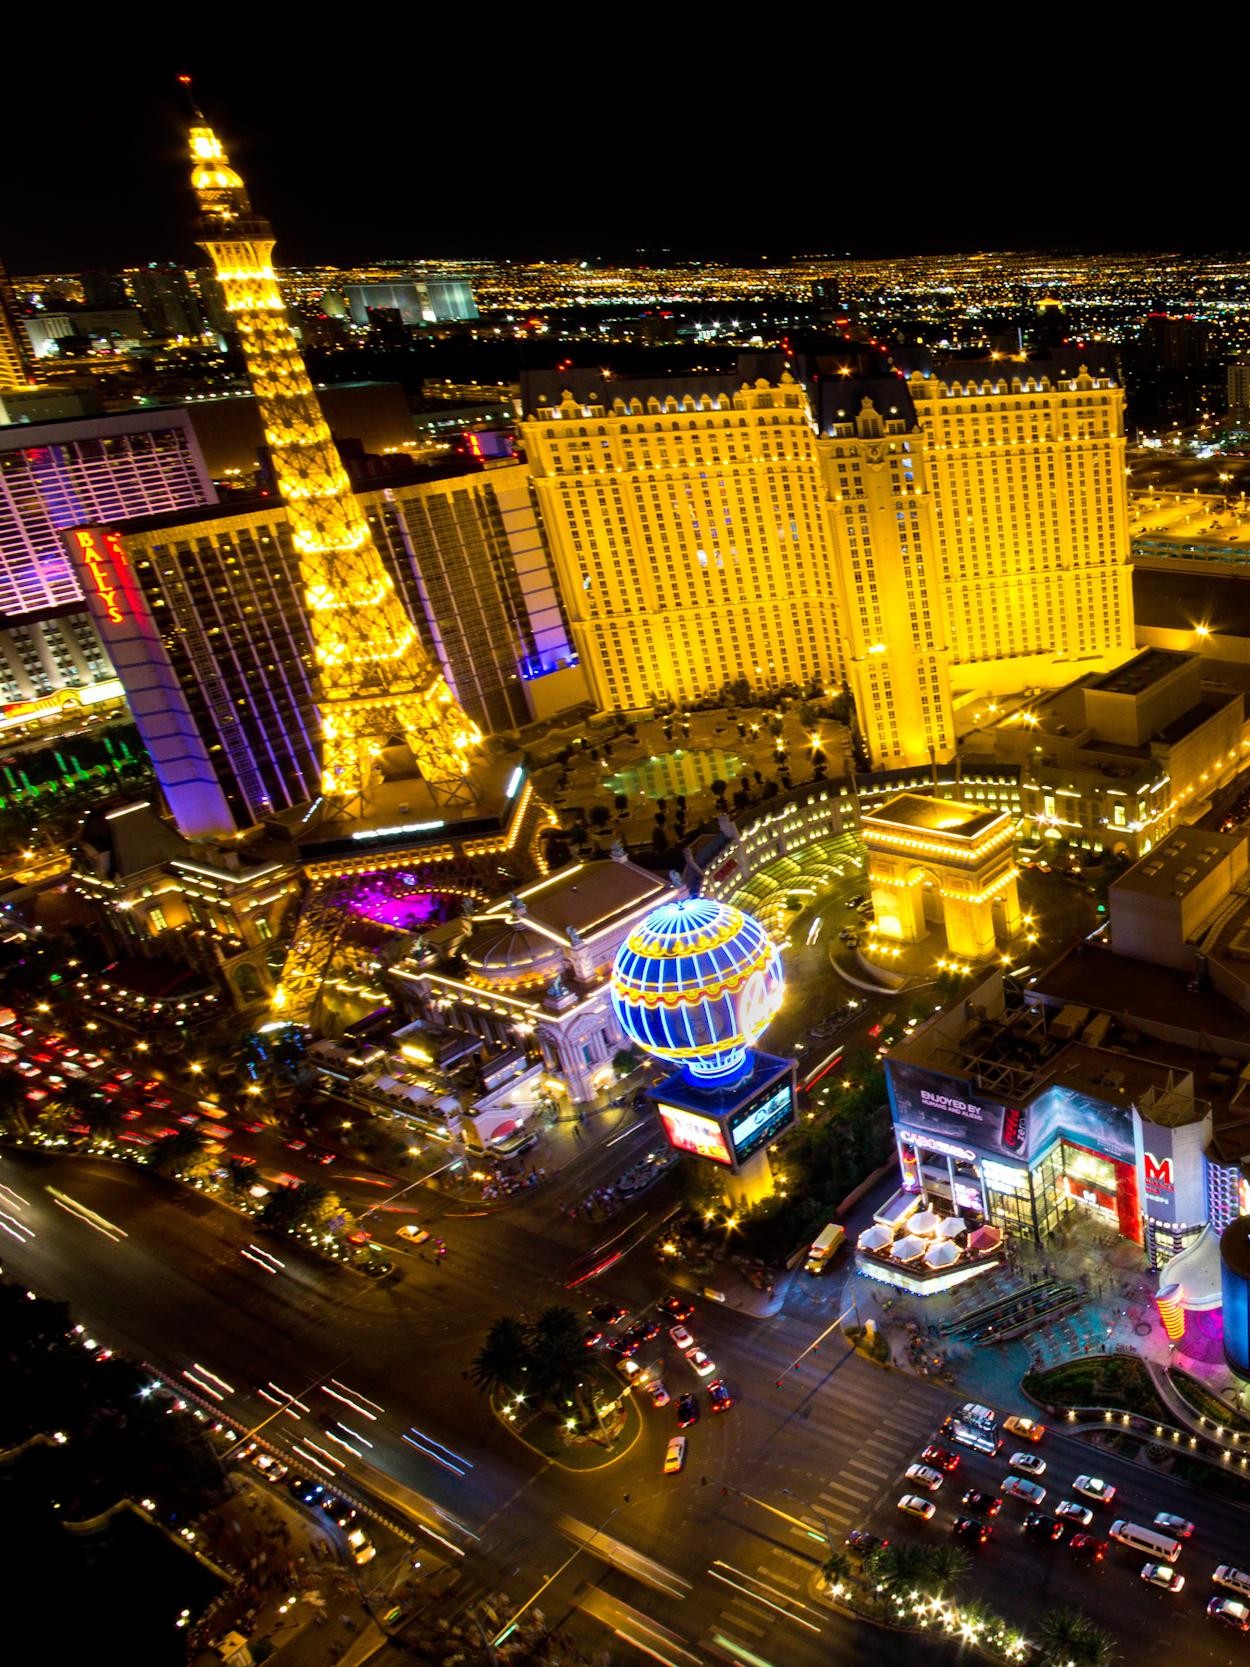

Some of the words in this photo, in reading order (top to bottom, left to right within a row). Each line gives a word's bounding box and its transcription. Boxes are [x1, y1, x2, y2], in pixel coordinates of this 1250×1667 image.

[921, 1090, 967, 1110] ENJOYED
[967, 1104, 982, 1115] BY
[1144, 1151, 1174, 1185] M
